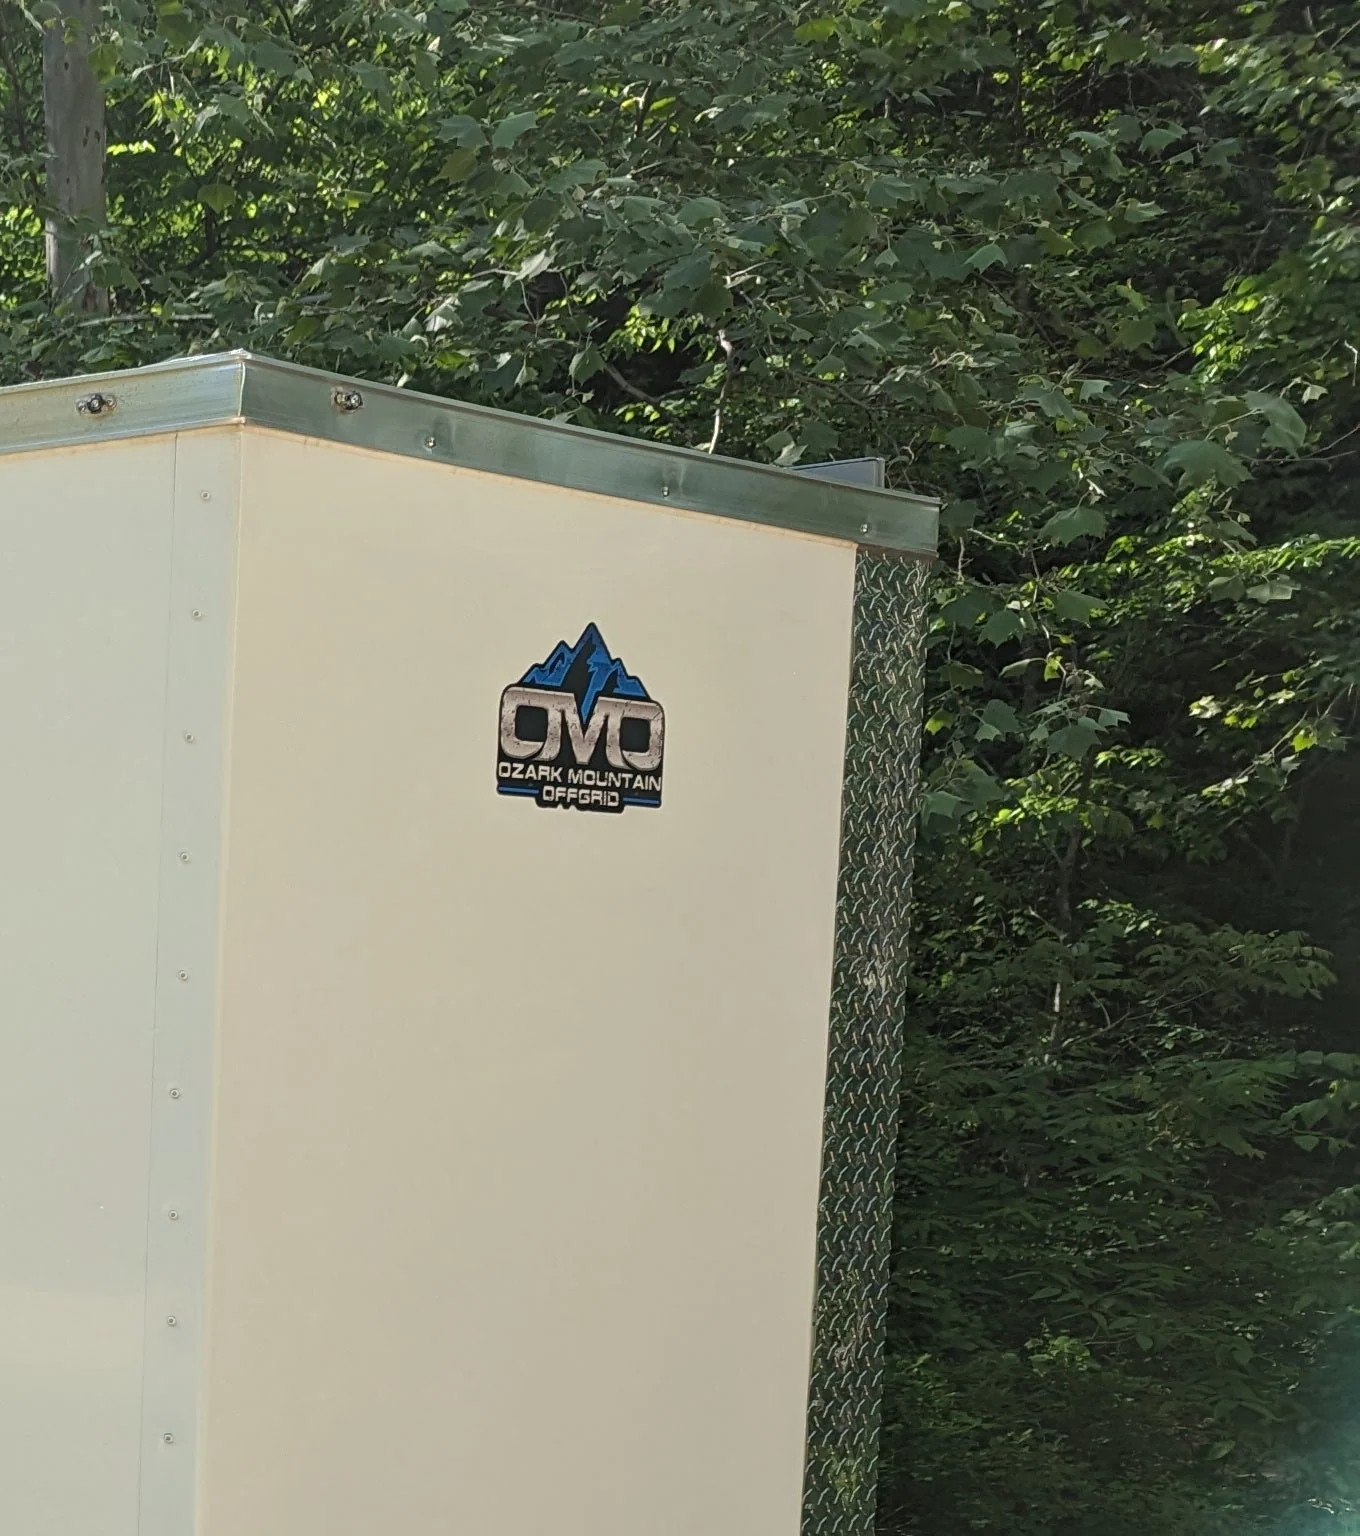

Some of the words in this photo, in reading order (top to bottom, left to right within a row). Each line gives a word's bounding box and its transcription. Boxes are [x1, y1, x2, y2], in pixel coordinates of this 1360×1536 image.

[498, 762, 562, 783] OZARK
[567, 768, 662, 792] MOUNTAIN
[542, 786, 620, 807] OFFGRID
